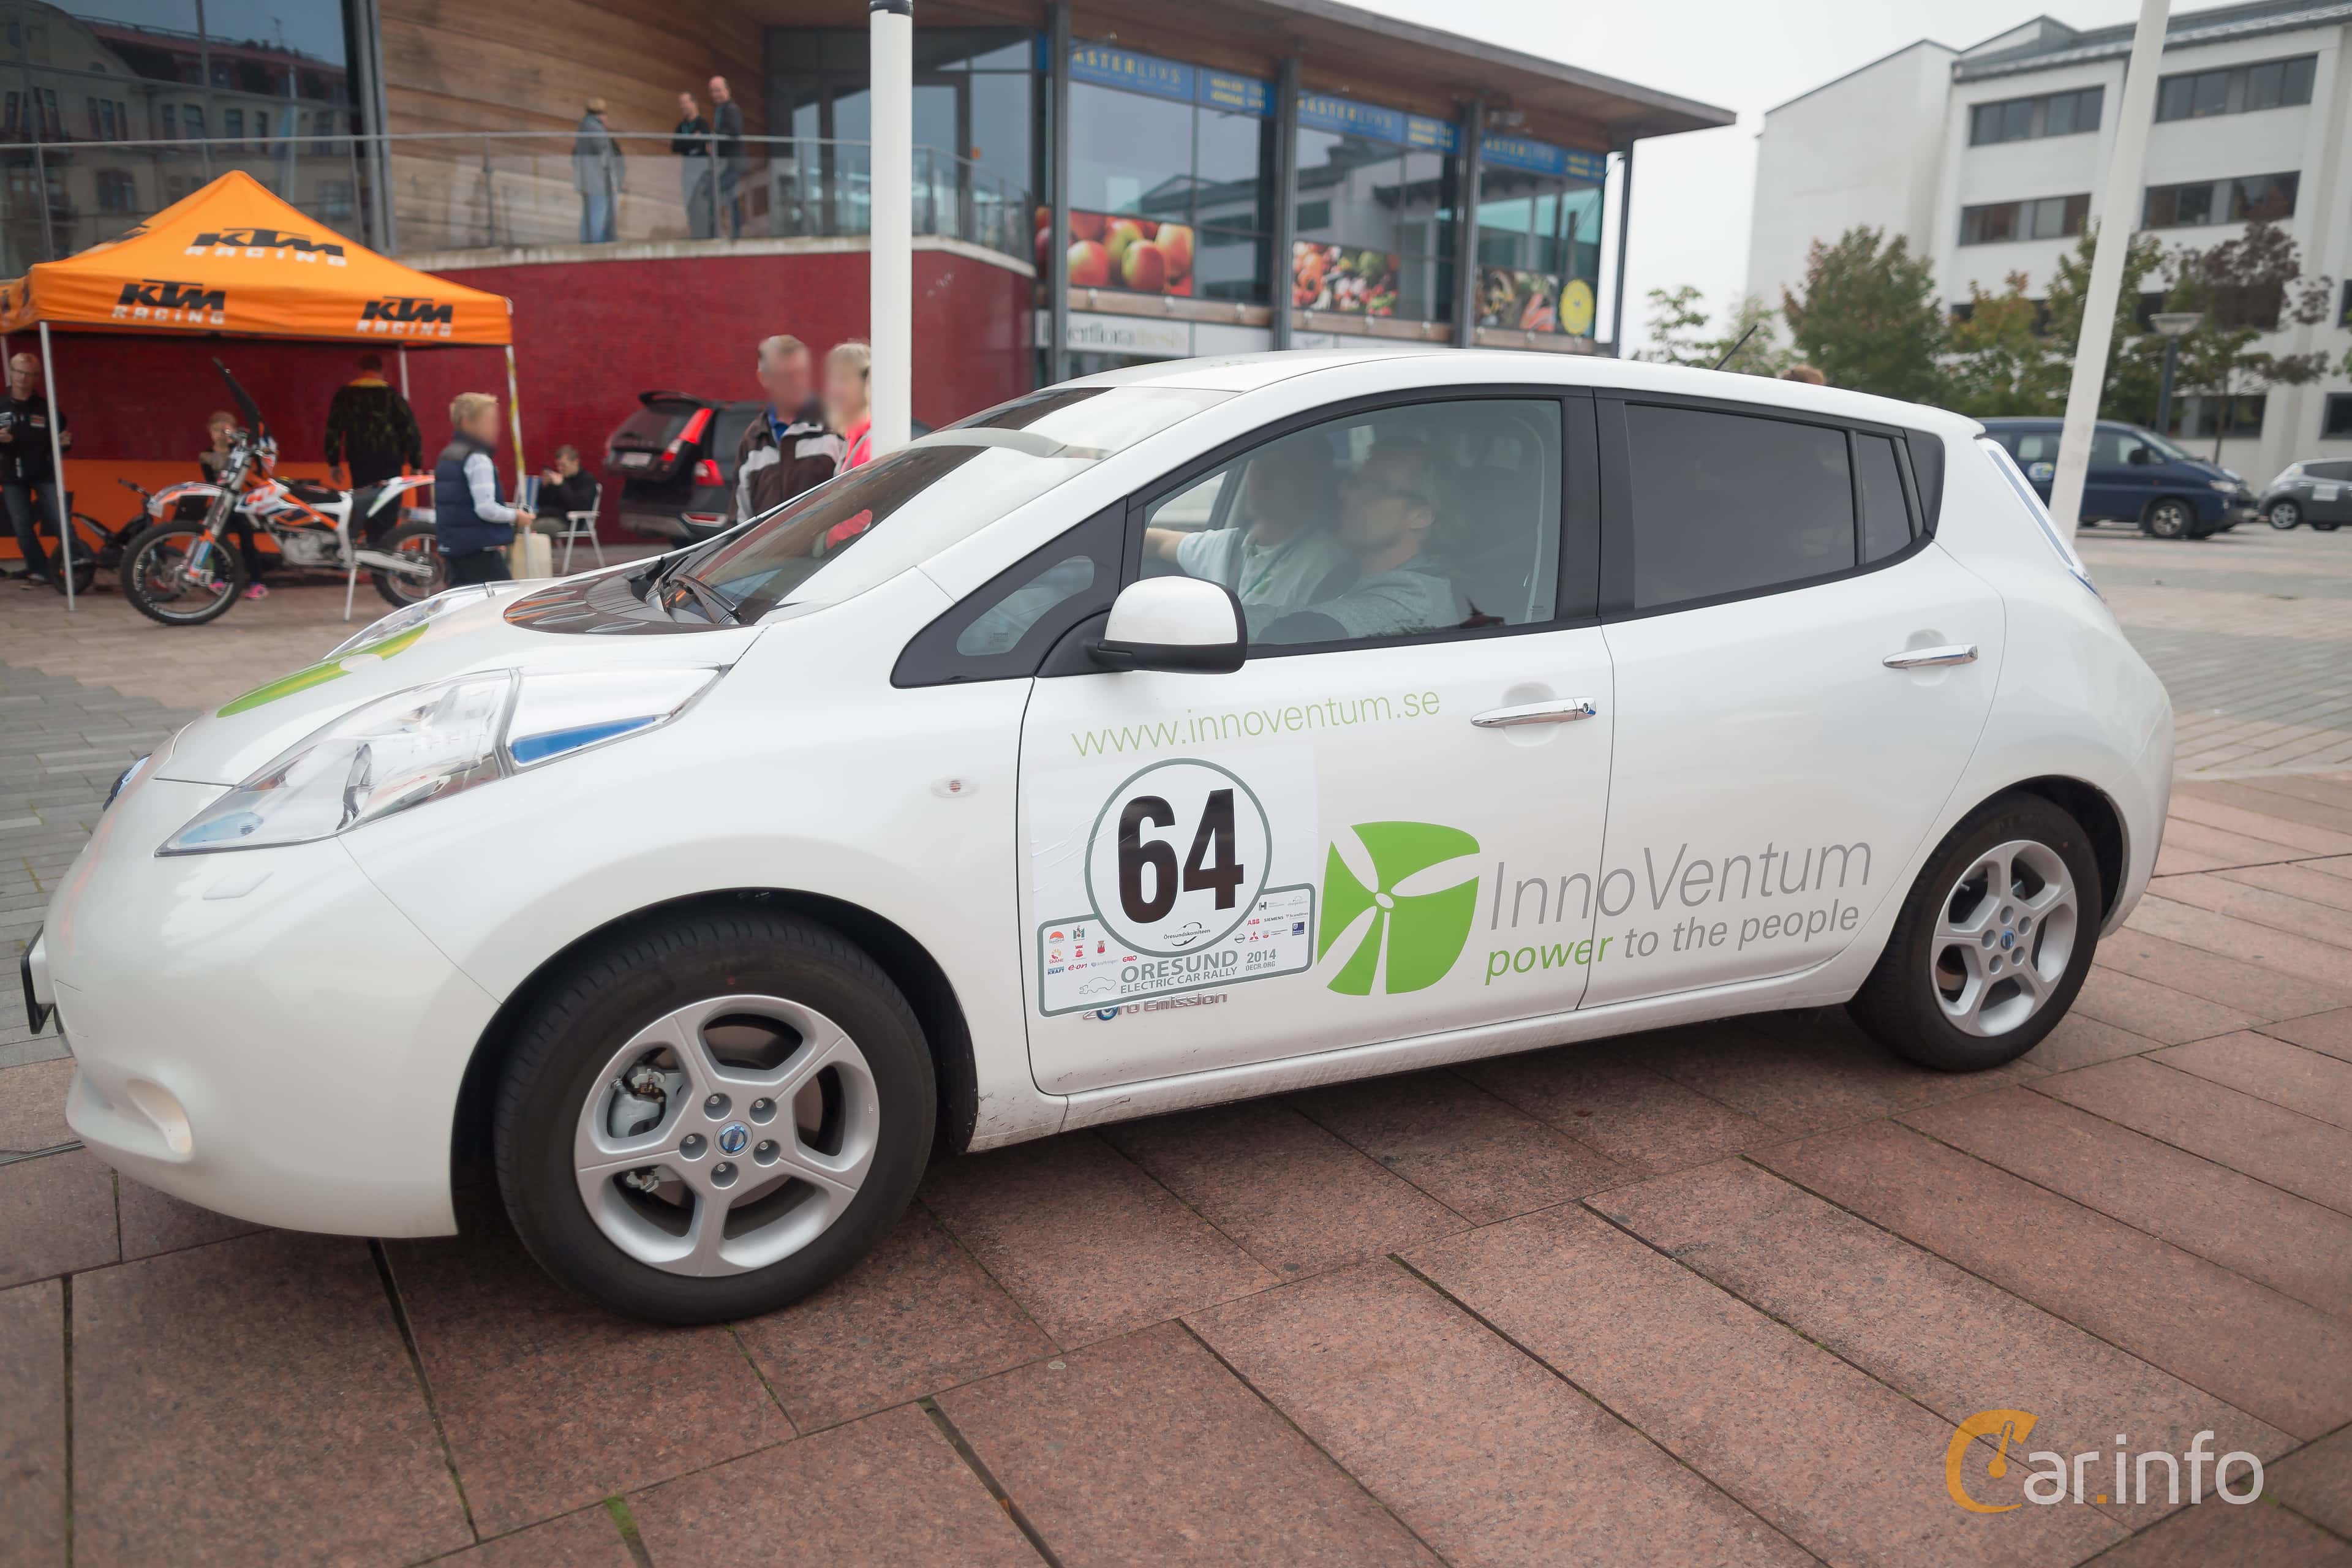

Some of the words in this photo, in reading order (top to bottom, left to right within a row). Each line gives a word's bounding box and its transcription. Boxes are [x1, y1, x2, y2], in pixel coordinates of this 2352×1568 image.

[191, 227, 344, 257] KTM
[118, 279, 226, 311] KTM
[361, 296, 454, 323] KTM
[1071, 690, 1441, 757] www.innoventum.se
[1118, 788, 1244, 924] 64
[1491, 842, 1871, 930] InnoVentum
[1164, 929, 1210, 940] Öresundskomiteen
[1484, 937, 1614, 986] power
[1624, 927, 1659, 959] to
[1673, 916, 1728, 951] the
[1738, 899, 1859, 951] people
[1121, 950, 1238, 983] ORESUND
[1245, 961, 1276, 971] OECR.ORG
[1246, 949, 1276, 963] 2014
[1120, 977, 1175, 994] ELECTRIC
[1177, 973, 1200, 984] CAR
[1204, 967, 1237, 979] RALLY
[1144, 992, 1228, 1011] Emission
